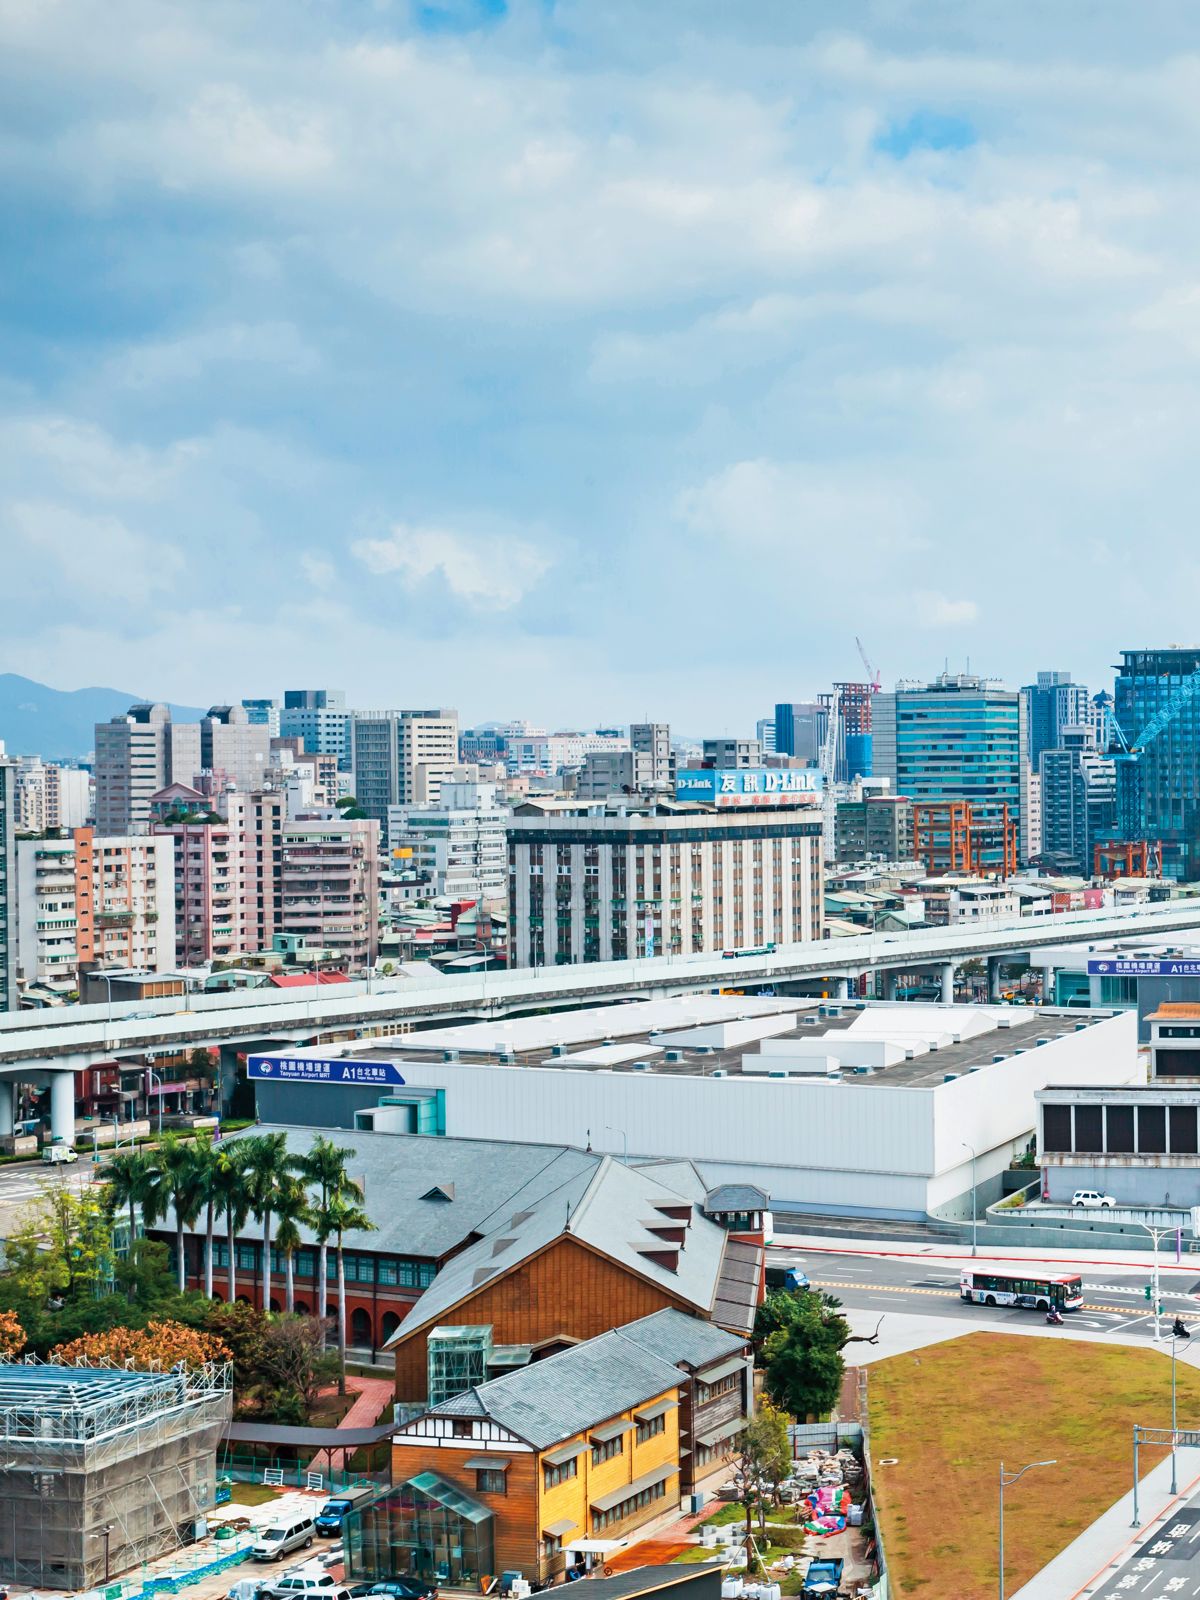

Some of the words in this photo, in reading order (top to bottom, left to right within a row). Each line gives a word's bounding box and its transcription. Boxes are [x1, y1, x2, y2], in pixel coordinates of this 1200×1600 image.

[678, 779, 712, 788] D-Link
[721, 774, 758, 791] 友訊
[765, 772, 817, 791] D-Link
[1171, 965, 1183, 973] A1
[280, 1070, 300, 1078] Taoyuan
[301, 1071, 318, 1079] Airport
[342, 1067, 356, 1079] A1
[357, 1066, 386, 1077] 台北車站
